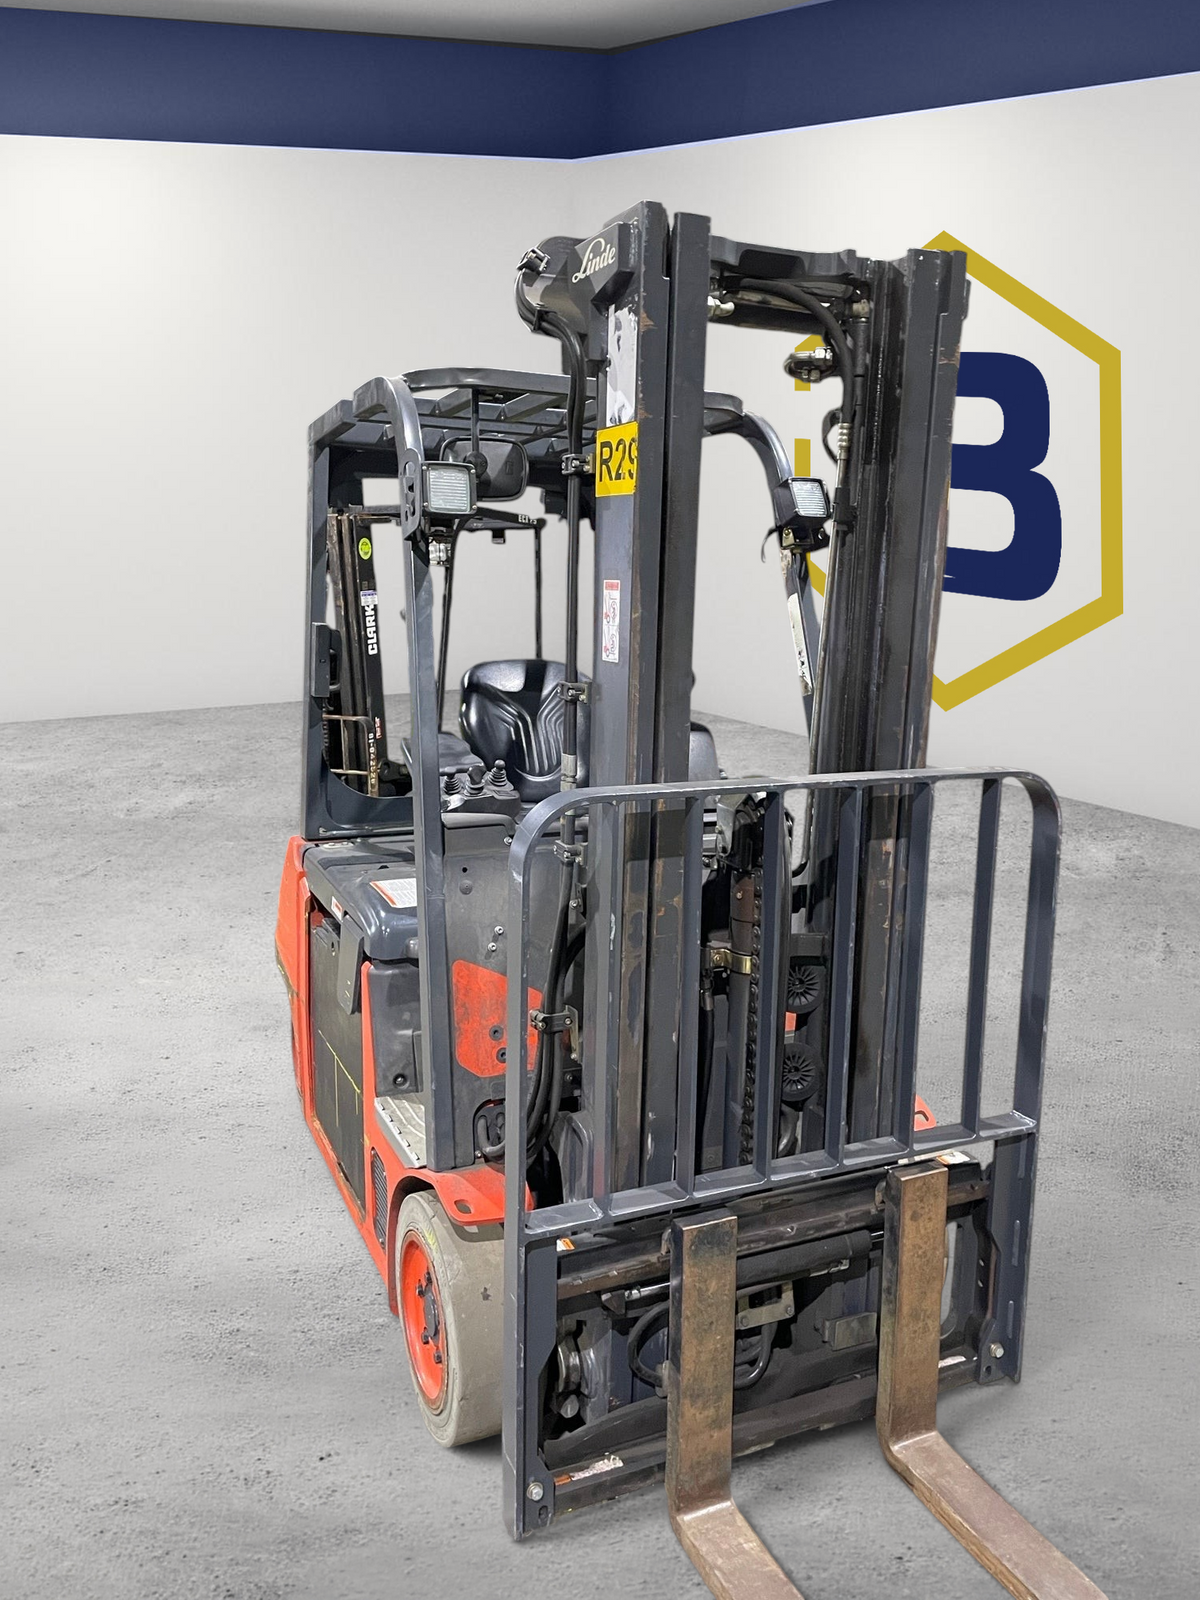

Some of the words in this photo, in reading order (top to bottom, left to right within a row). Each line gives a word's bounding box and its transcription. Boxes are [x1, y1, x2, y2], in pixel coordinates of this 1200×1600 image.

[571, 237, 616, 283] Linde
[942, 351, 1062, 601] B
[365, 604, 378, 655] CLARK
